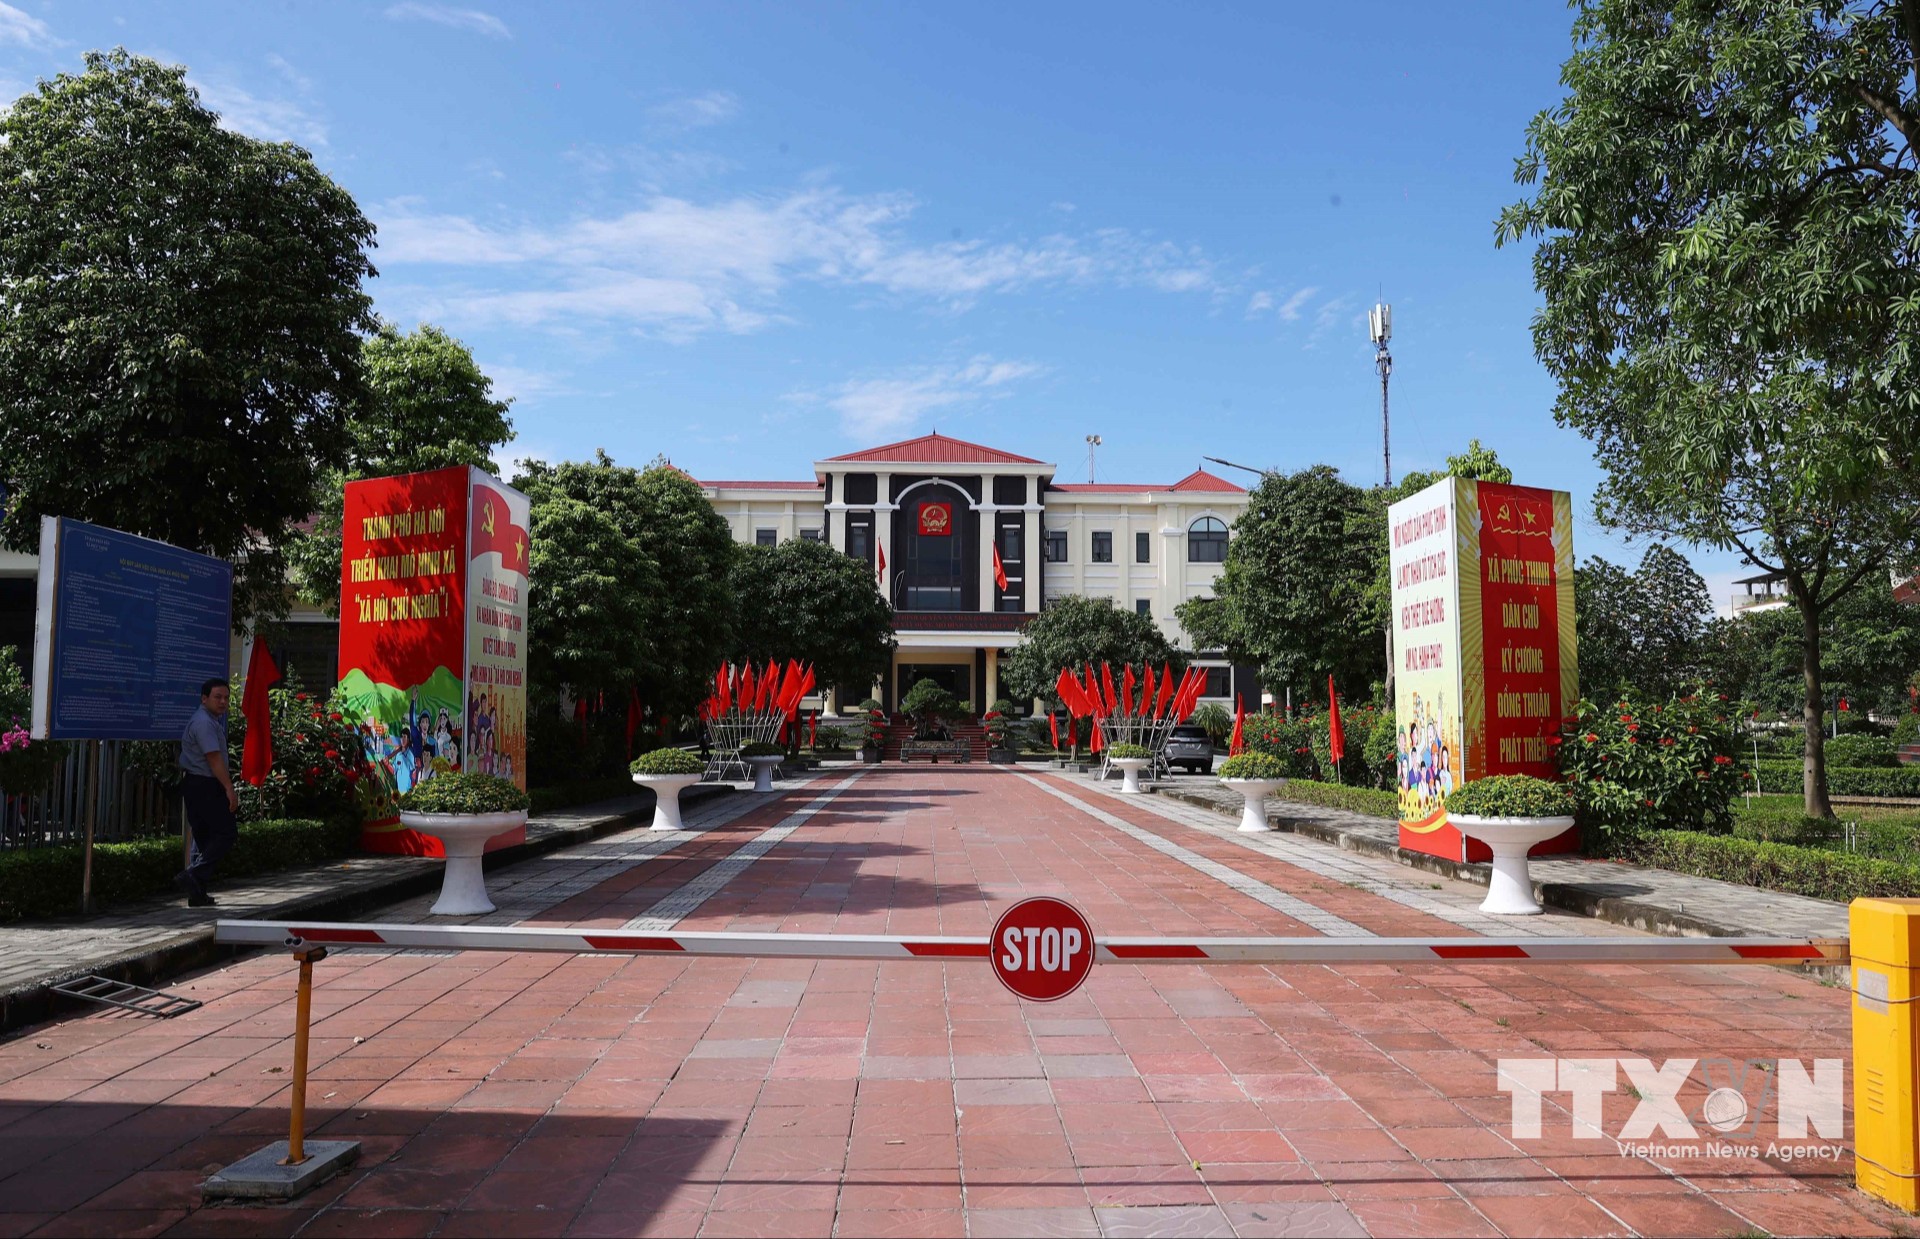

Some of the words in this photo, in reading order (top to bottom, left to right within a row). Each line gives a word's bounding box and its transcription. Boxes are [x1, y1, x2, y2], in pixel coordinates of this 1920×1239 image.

[363, 512, 391, 541] THÀNH
[394, 504, 412, 537] PHỐ
[414, 506, 426, 535] HÀ
[428, 504, 445, 538] NỘI
[351, 548, 375, 582] TRIỂN
[378, 555, 398, 580] KHAI
[401, 548, 416, 578] MÔ
[418, 547, 440, 576] HÌNH
[443, 545, 456, 574] XÃ
[1488, 554, 1500, 582] XÃ
[1501, 555, 1524, 585] PHÚC
[1526, 560, 1550, 591] THỊNH
[374, 593, 388, 626] HỘI
[390, 588, 409, 621] CHỦ
[1503, 598, 1520, 629] DÂN
[1522, 598, 1539, 629] CHỦ
[1502, 639, 1513, 673] KỶ
[1515, 646, 1543, 674] CƯƠNG
[1498, 684, 1520, 718] ĐỒNG
[1523, 688, 1550, 723] THUẬN
[1500, 733, 1522, 763] PHÁT
[1002, 926, 1082, 972] STOP
